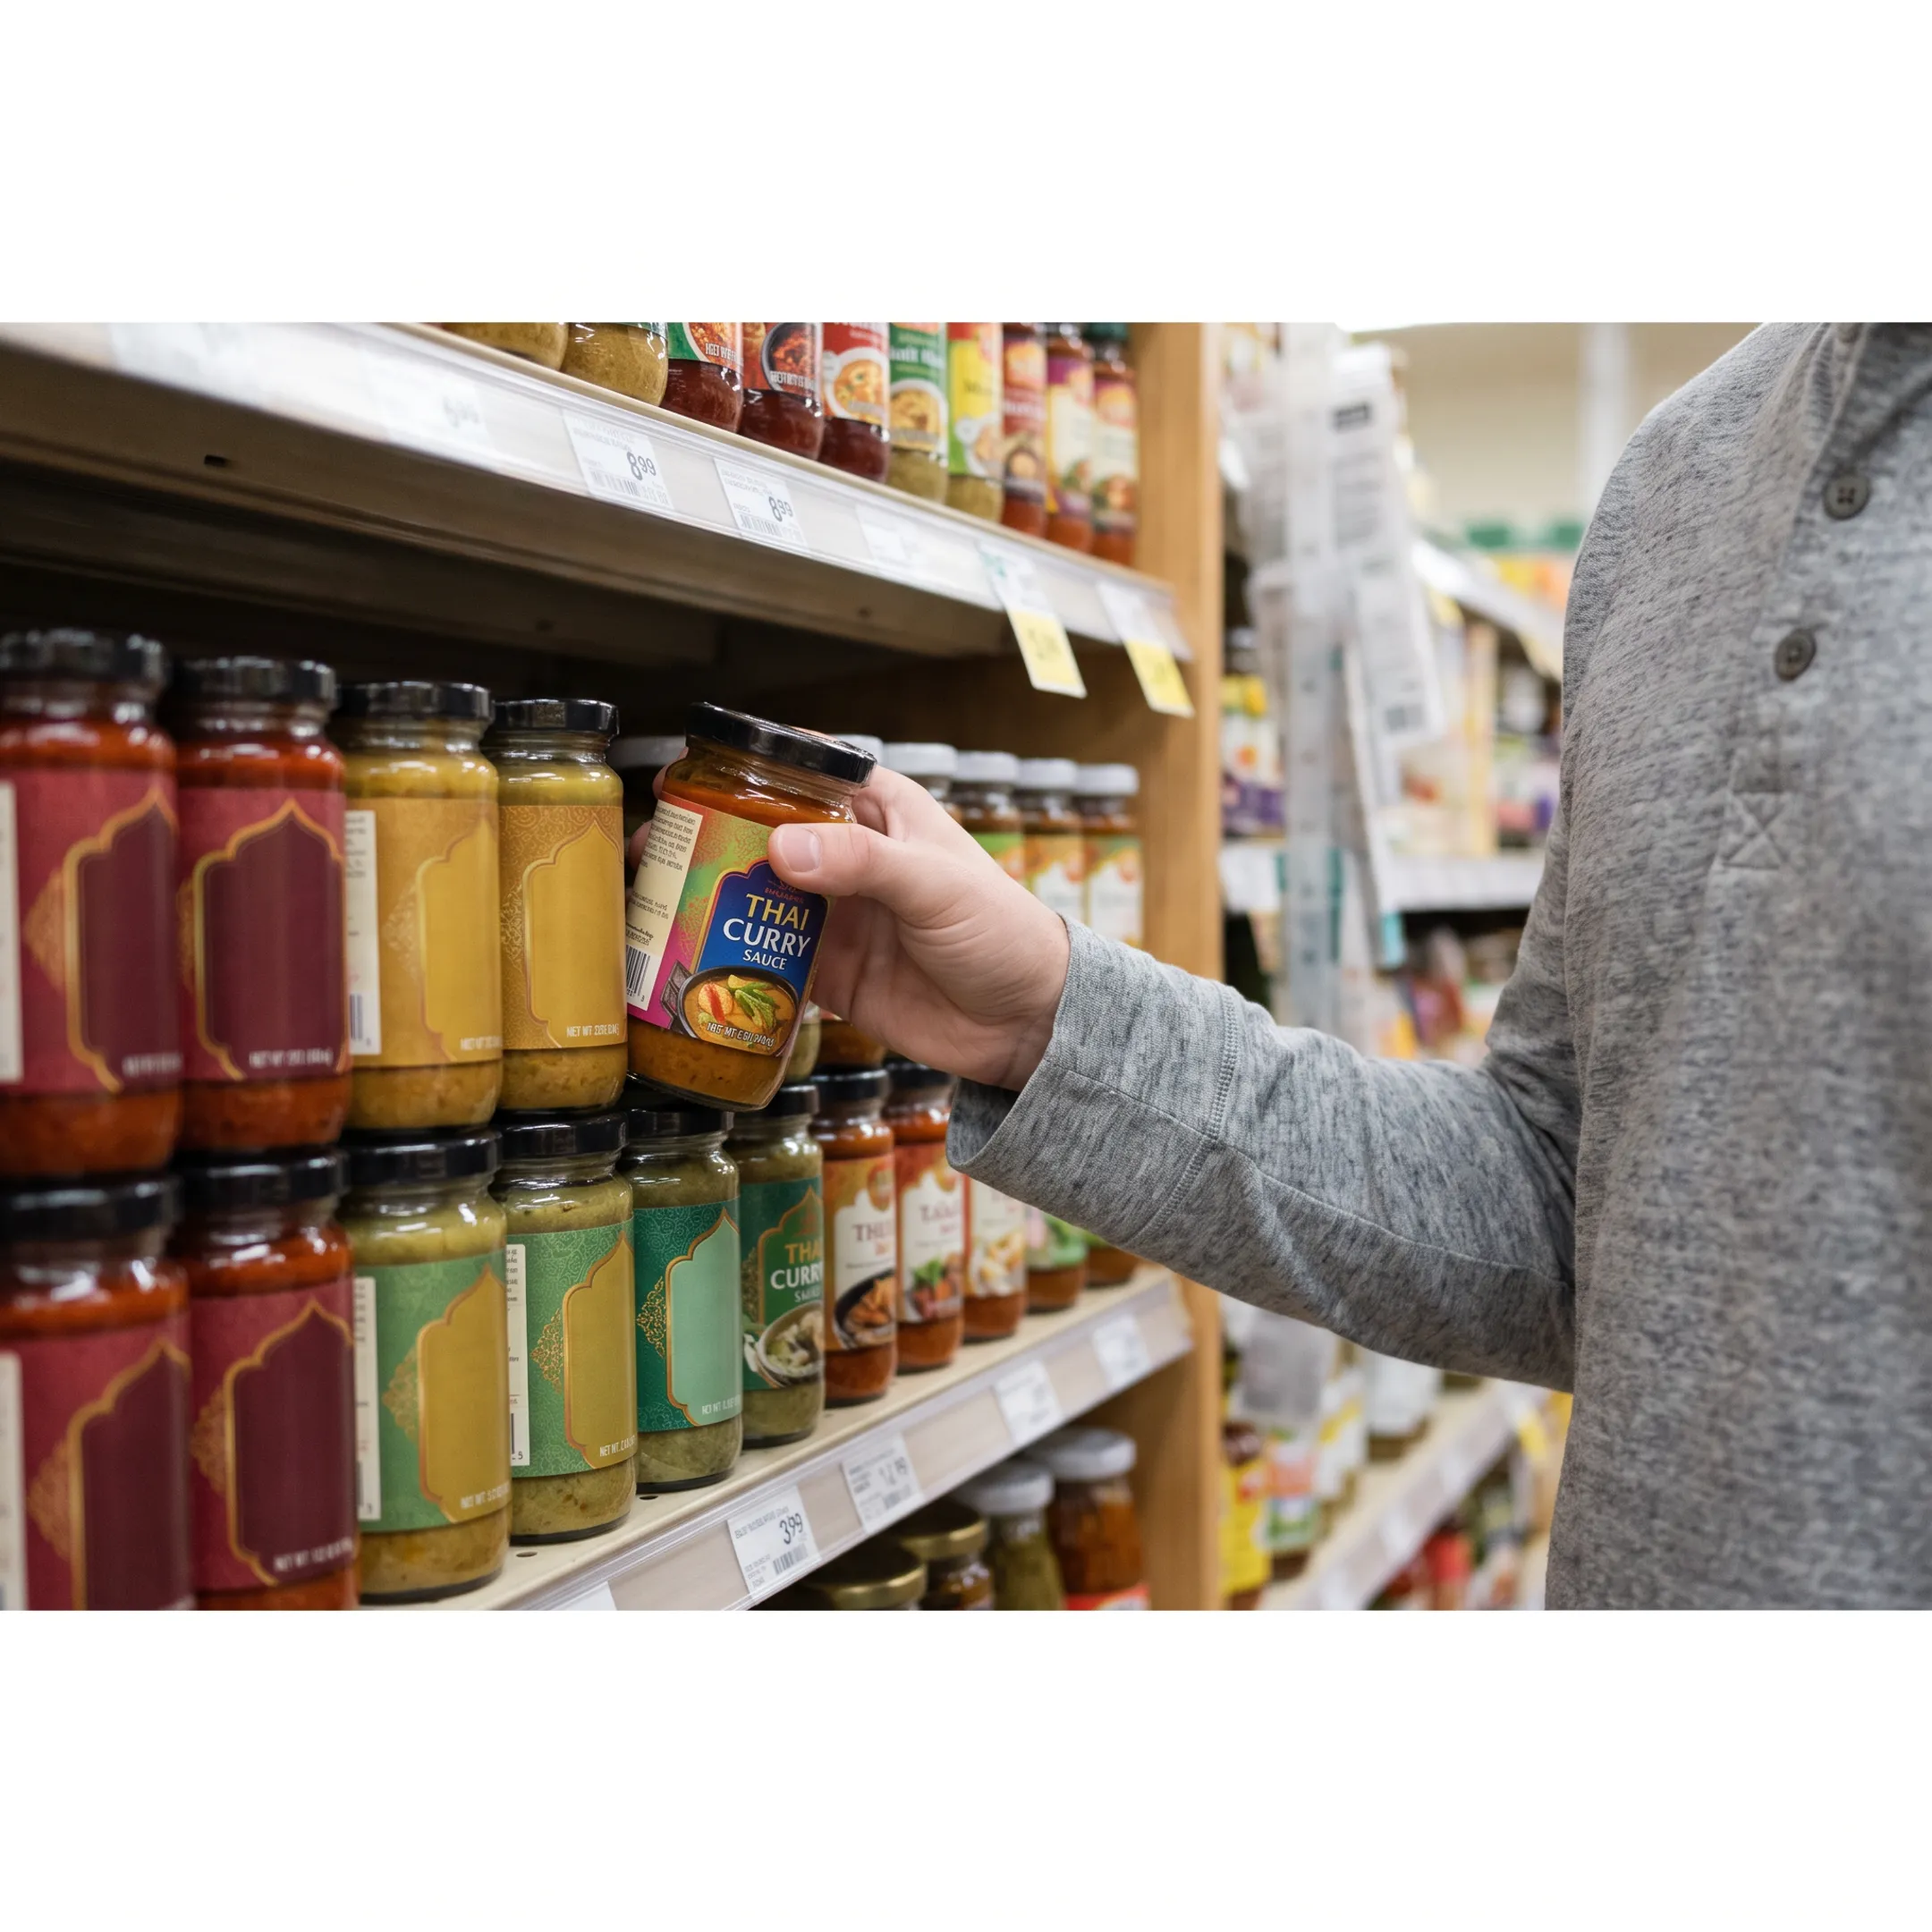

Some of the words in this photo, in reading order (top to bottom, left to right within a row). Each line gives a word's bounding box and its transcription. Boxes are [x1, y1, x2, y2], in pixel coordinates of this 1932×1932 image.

[746, 894, 810, 931] THAI
[723, 918, 811, 958] CURRY
[742, 949, 788, 970] SAUCE
[784, 1240, 824, 1265] THA
[779, 1513, 803, 1546] 399
